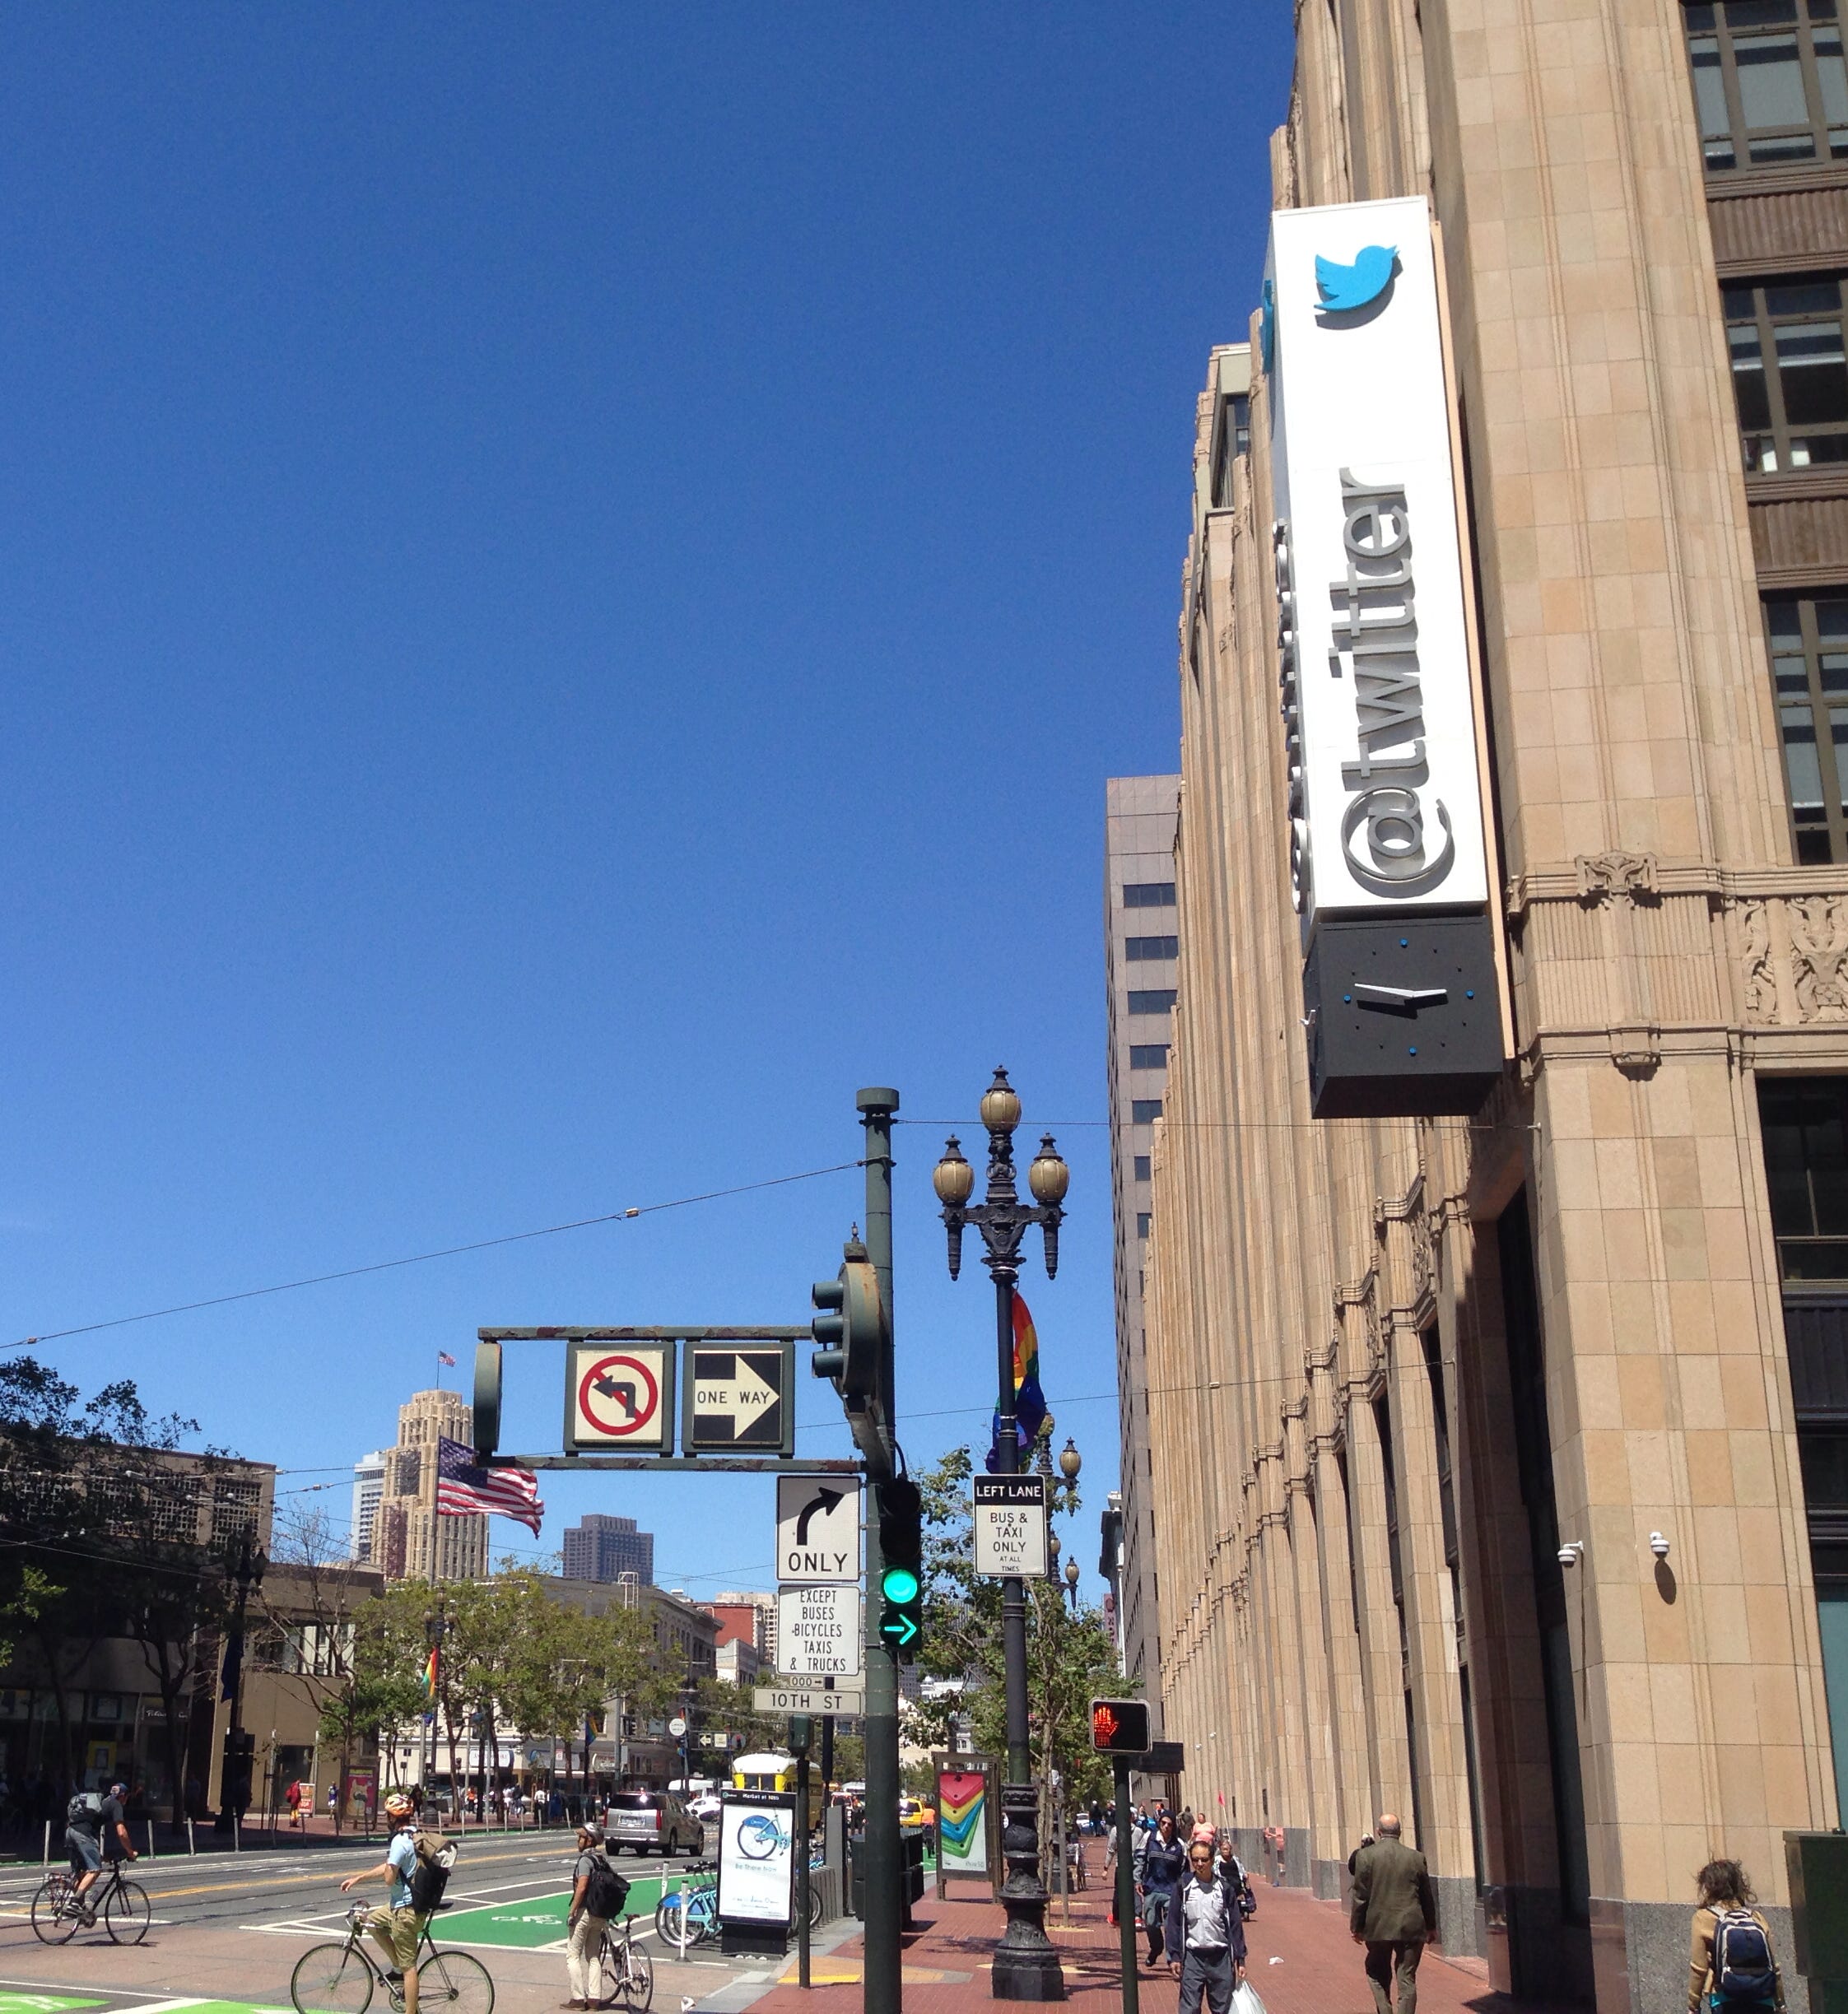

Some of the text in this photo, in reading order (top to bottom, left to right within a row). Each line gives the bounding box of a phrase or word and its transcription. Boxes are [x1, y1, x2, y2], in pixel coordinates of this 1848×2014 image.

[1329, 467, 1454, 897] @twitter
[697, 1391, 770, 1404] ONE WAY
[976, 1486, 1041, 1497] LEFT LANE
[990, 1513, 1028, 1523] BUS &
[995, 1527, 1022, 1538] TAXI
[993, 1541, 1026, 1552] ONLY
[788, 1552, 848, 1572] ONLY
[800, 1589, 836, 1603] EXCEPT
[802, 1607, 835, 1621] BUSES
[794, 1623, 842, 1637] BICYCLES
[803, 1640, 832, 1654] TAXIS
[789, 1657, 846, 1672] & TRUCKS
[771, 1693, 843, 1709] 10TH ST
